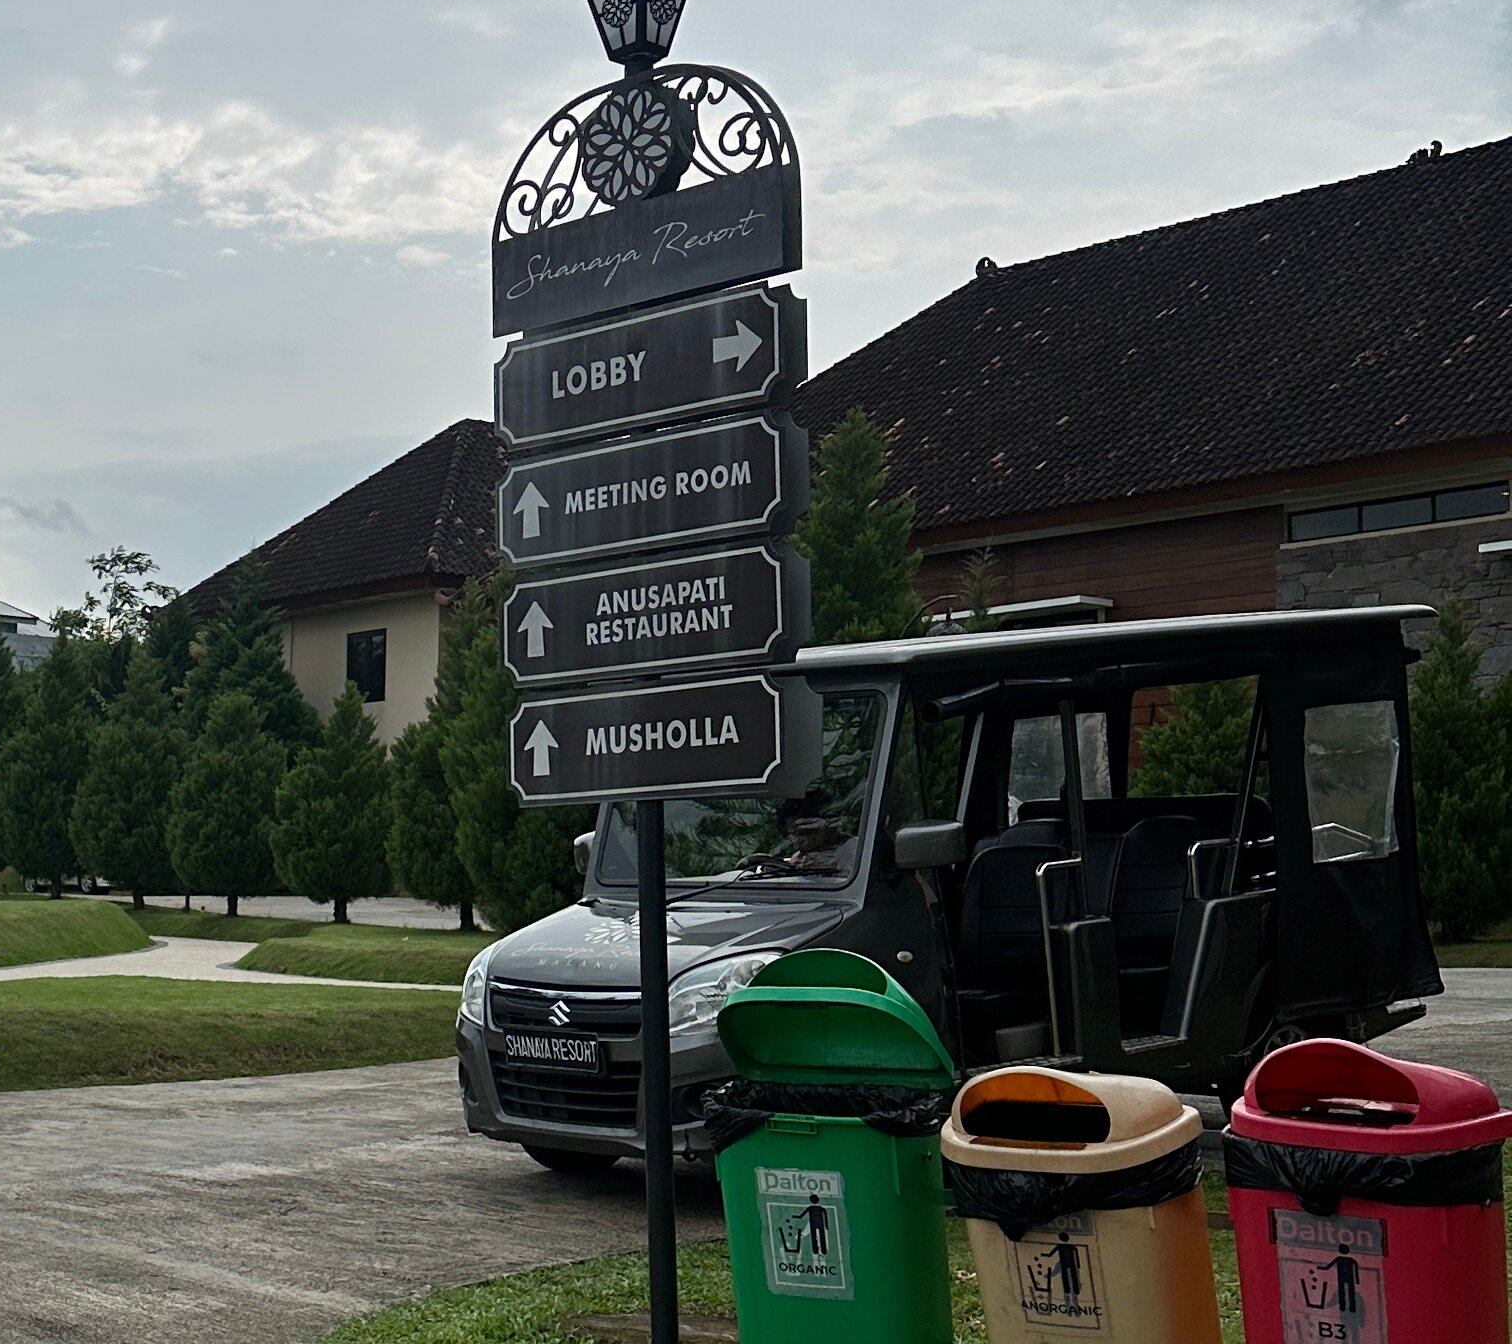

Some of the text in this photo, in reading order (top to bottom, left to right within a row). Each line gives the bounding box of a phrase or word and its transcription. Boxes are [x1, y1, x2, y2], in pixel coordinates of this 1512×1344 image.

[506, 209, 767, 300] Shanaya Resort
[551, 350, 647, 399] LOBBY
[564, 460, 752, 515] MEETING ROOM
[595, 575, 727, 617] ANUSAPATI
[585, 604, 733, 646] RESTAURANT
[585, 715, 739, 756] MUSHOLLA
[505, 1034, 597, 1063] SHANAYA RESORT
[1277, 1216, 1374, 1248] Dalton
[778, 1262, 838, 1276] ORGANIC
[1021, 1300, 1103, 1317] ANORGANIC
[1318, 1321, 1347, 1340] B3
